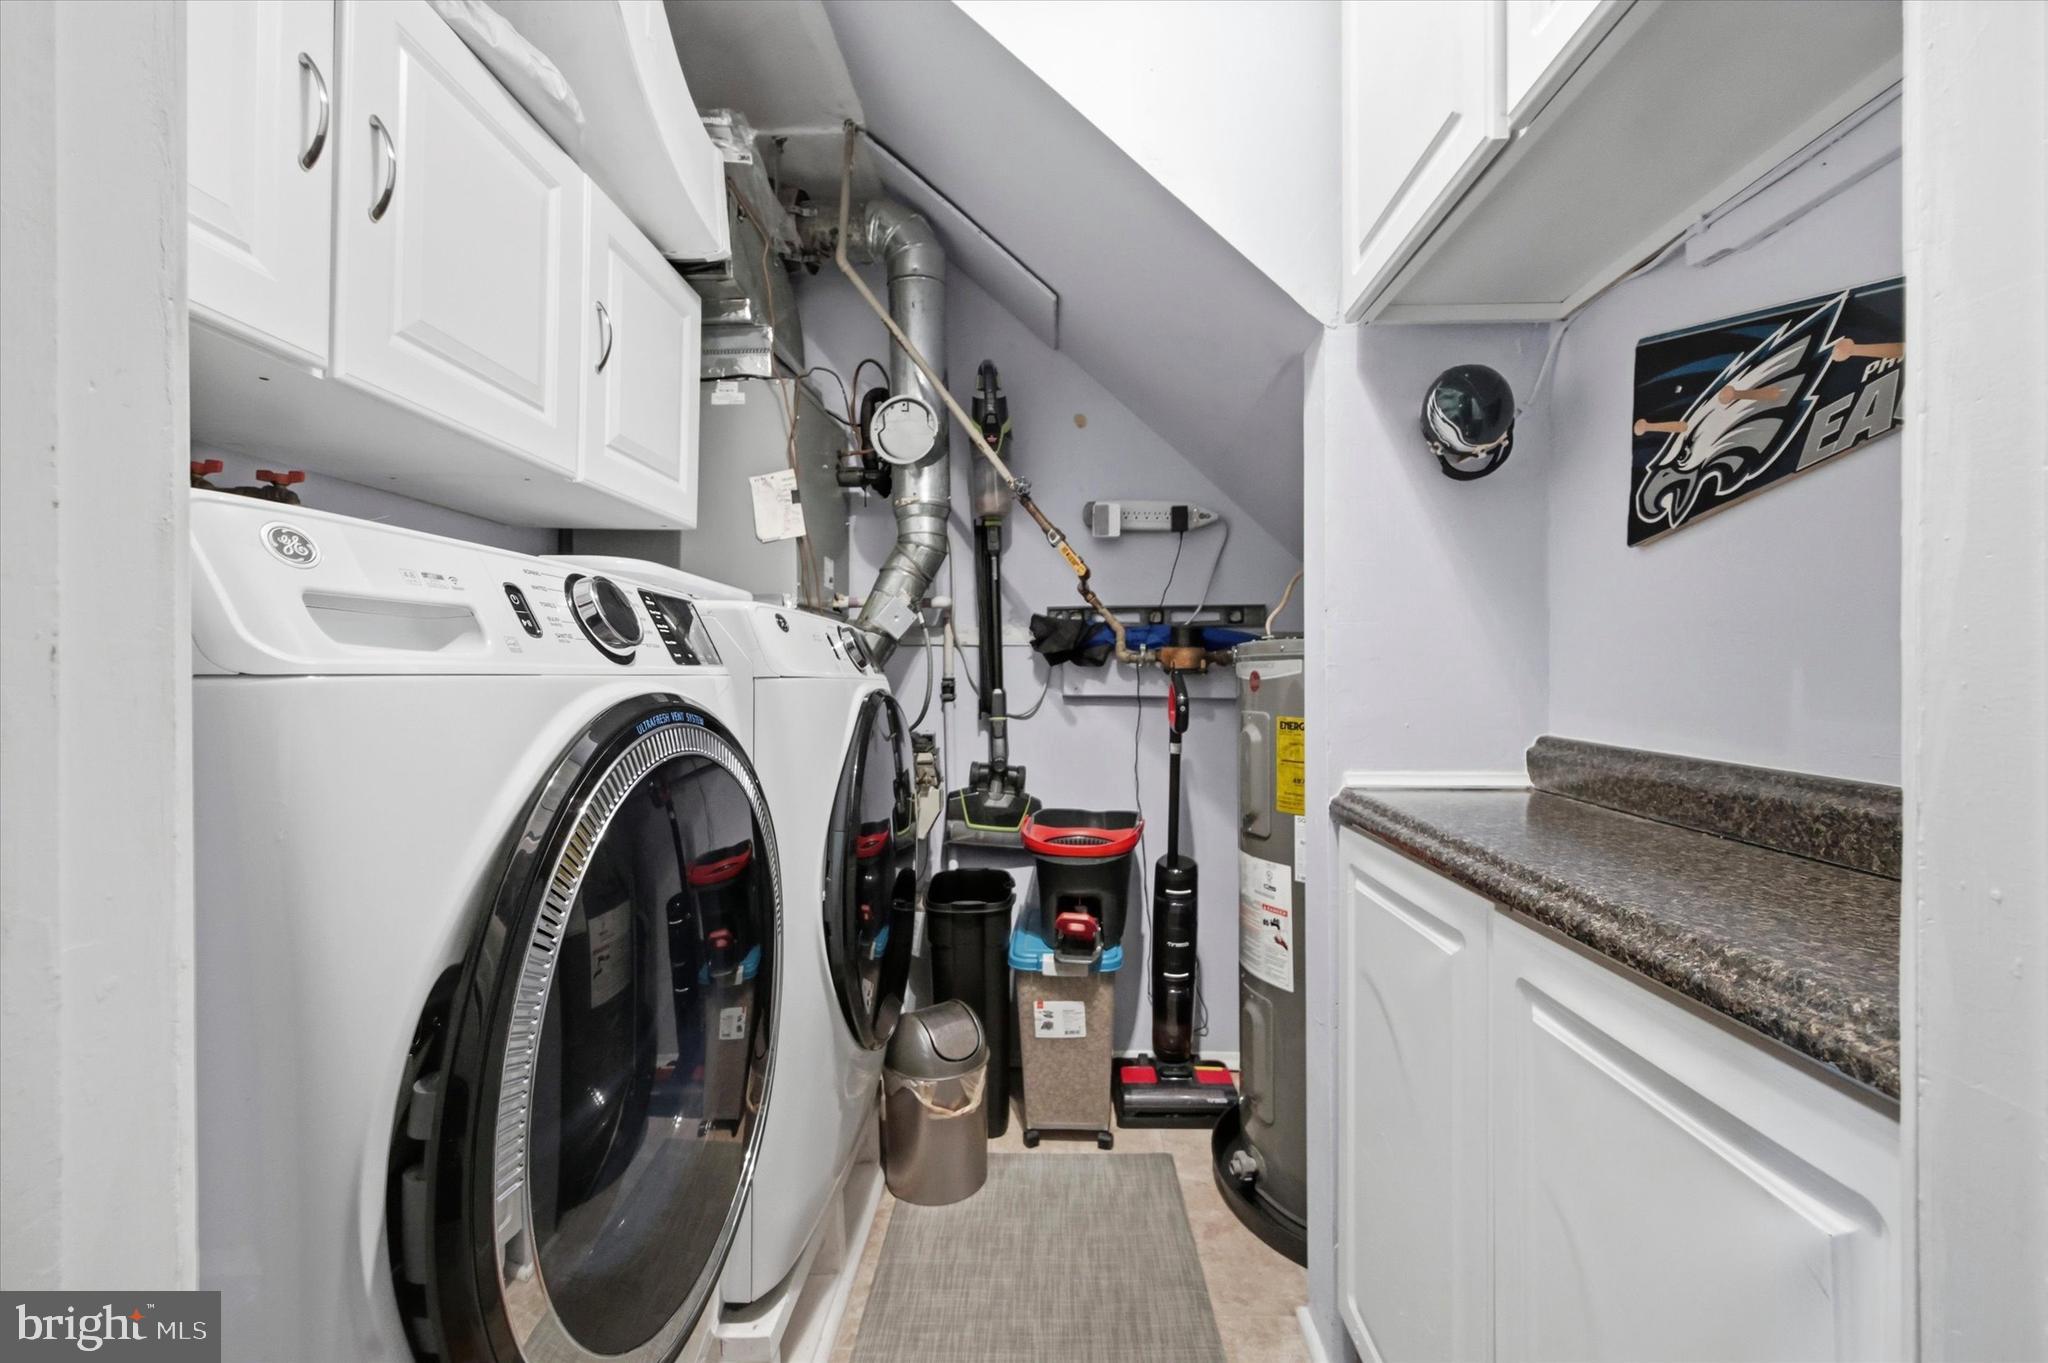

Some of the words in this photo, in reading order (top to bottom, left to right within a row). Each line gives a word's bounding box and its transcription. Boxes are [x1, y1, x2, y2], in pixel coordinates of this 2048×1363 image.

[1796, 368, 1904, 472] EA
[636, 713, 670, 735] ULTRAFRESH
[671, 711, 685, 721] VENT
[686, 712, 704, 726] SYSTEM
